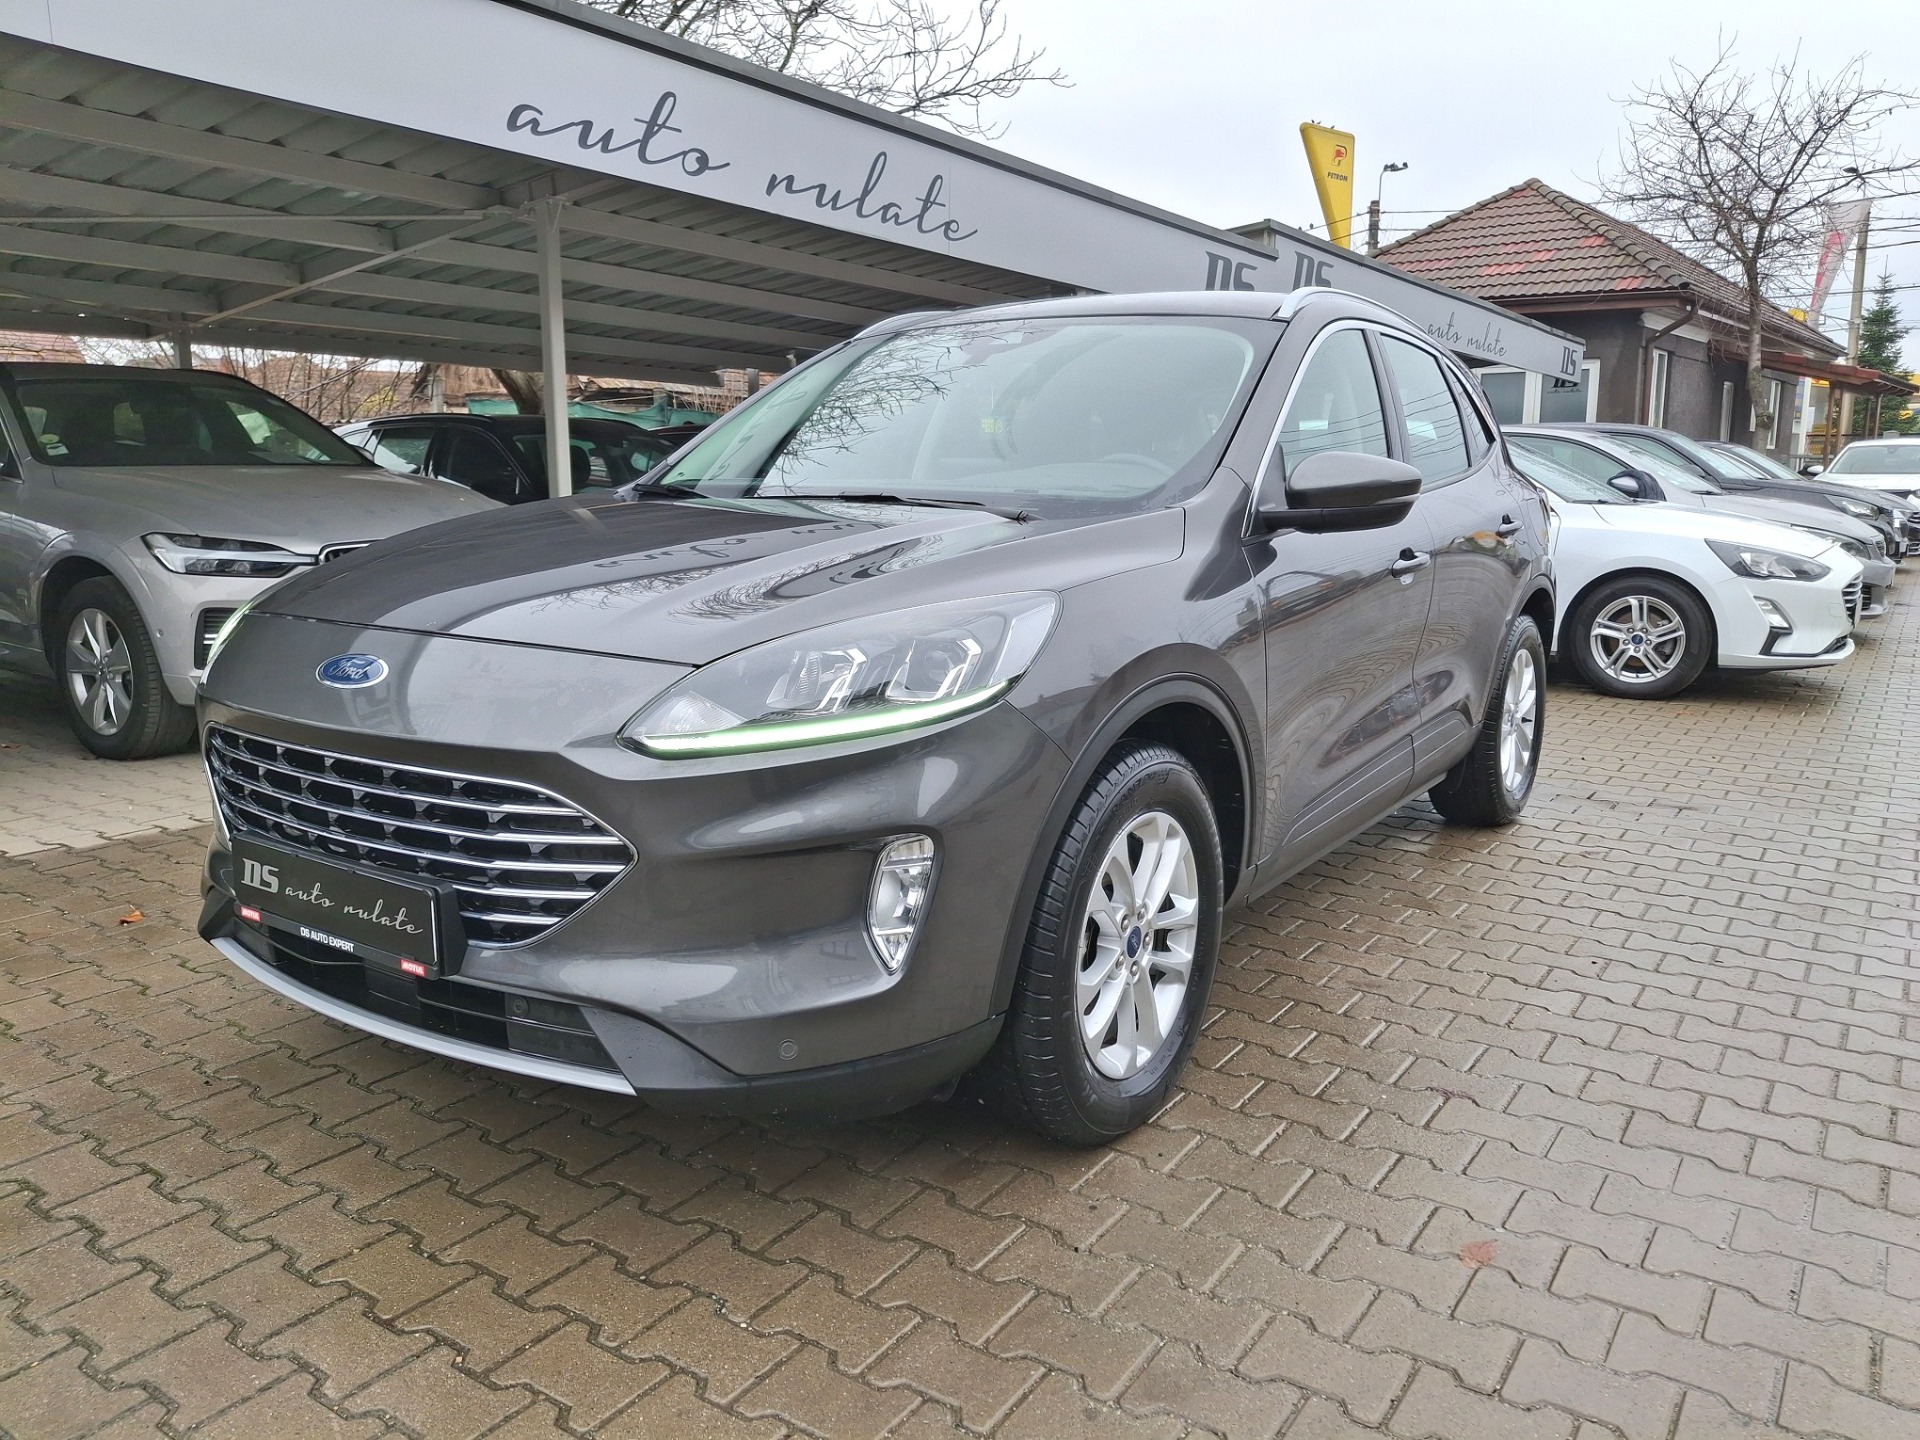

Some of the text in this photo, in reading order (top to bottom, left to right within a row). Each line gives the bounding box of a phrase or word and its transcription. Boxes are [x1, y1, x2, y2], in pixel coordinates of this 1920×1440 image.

[507, 91, 979, 242] auto rulate
[1326, 171, 1349, 182] PETROM
[1205, 250, 1258, 291] DS
[1292, 250, 1335, 292] DS
[1427, 311, 1508, 357] auto rulate
[1560, 346, 1578, 376] DS
[327, 659, 372, 680] Ford
[240, 857, 424, 934] DS auto rulate
[300, 926, 355, 953] DS AUTO EXPERT
